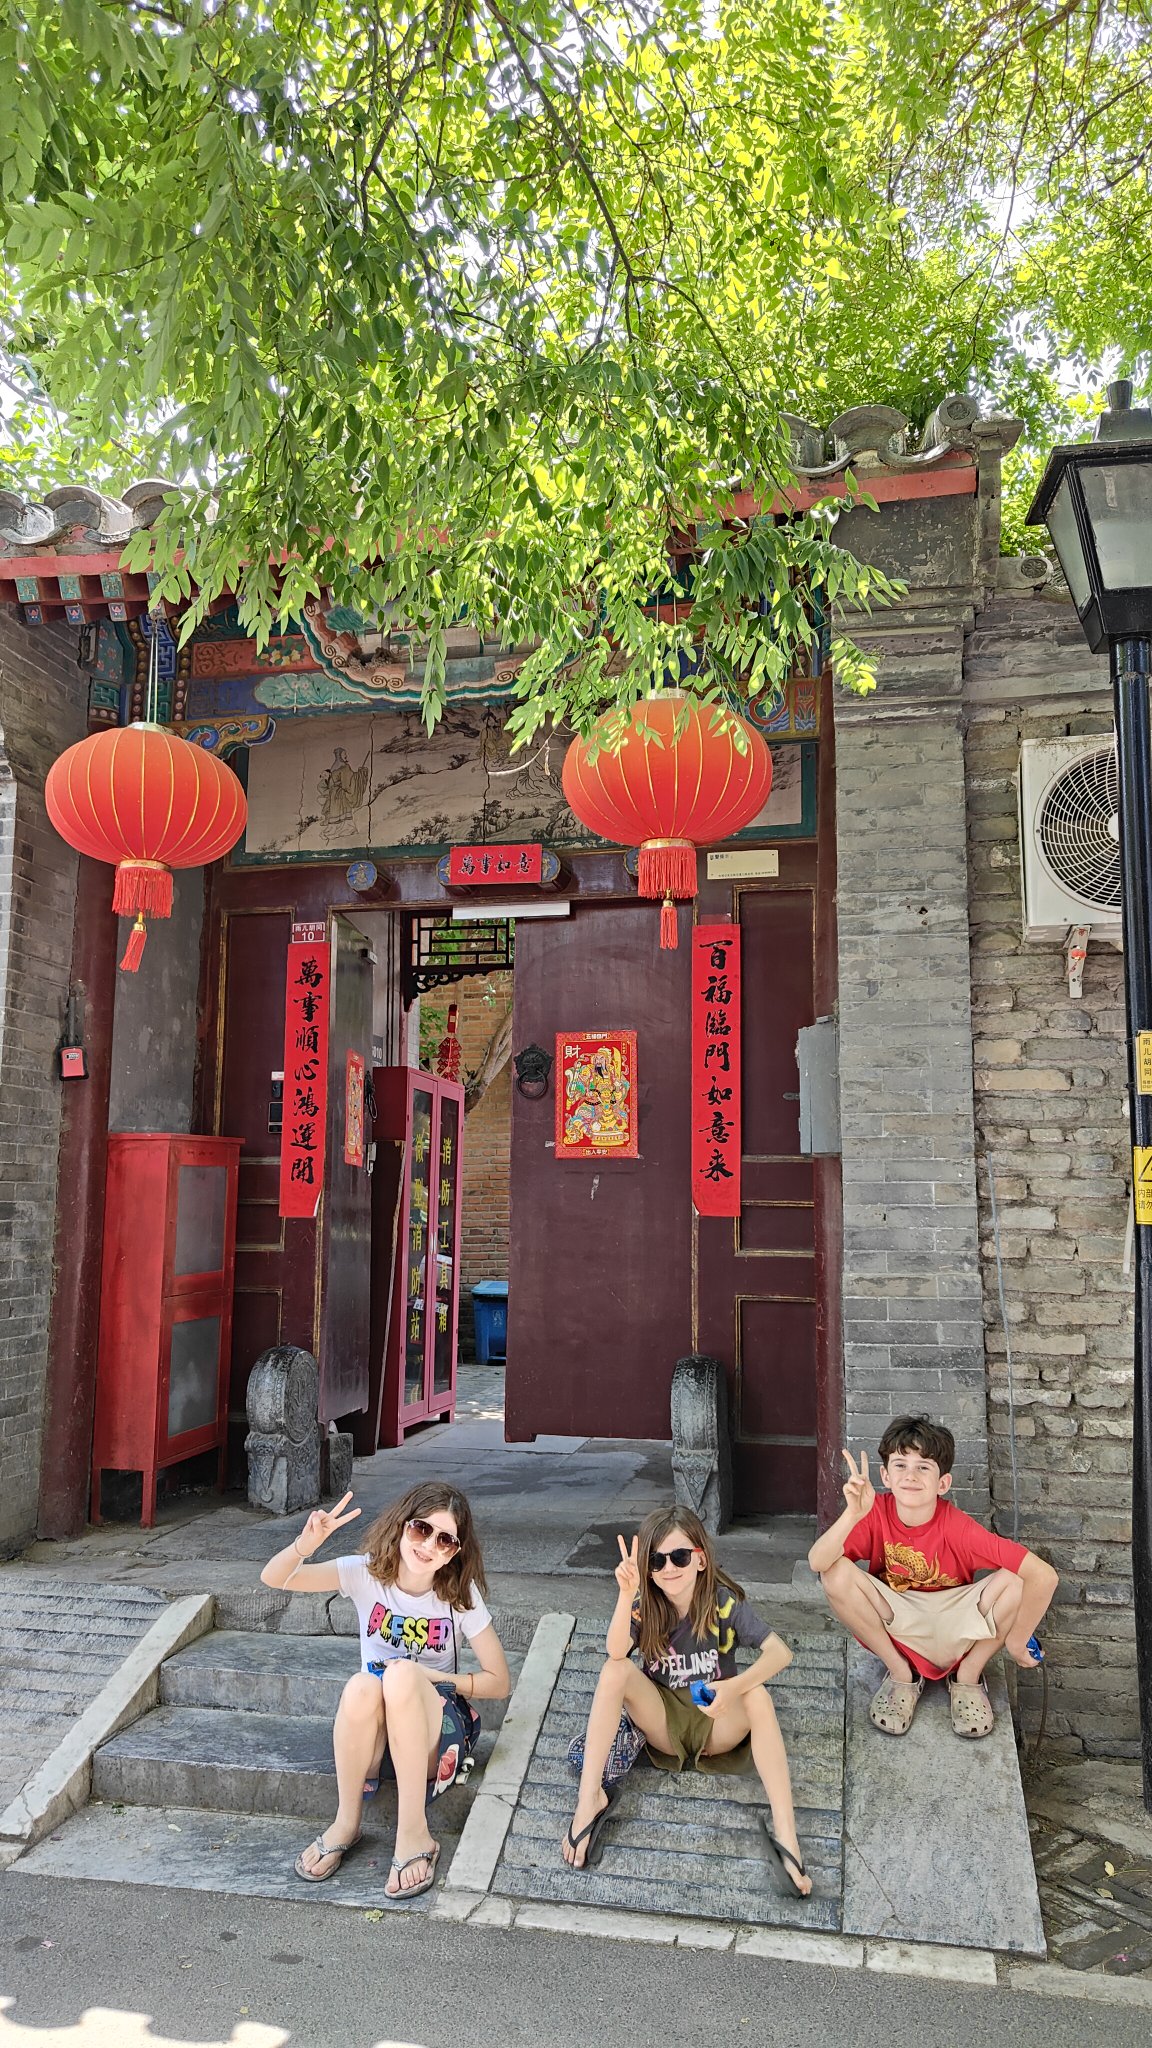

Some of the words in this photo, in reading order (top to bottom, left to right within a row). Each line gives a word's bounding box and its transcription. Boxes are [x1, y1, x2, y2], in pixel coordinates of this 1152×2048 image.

[459, 852, 533, 876] 萬事如意
[302, 931, 315, 941] 10
[564, 1044, 581, 1059] 財
[367, 1602, 454, 1654] BLESSED
